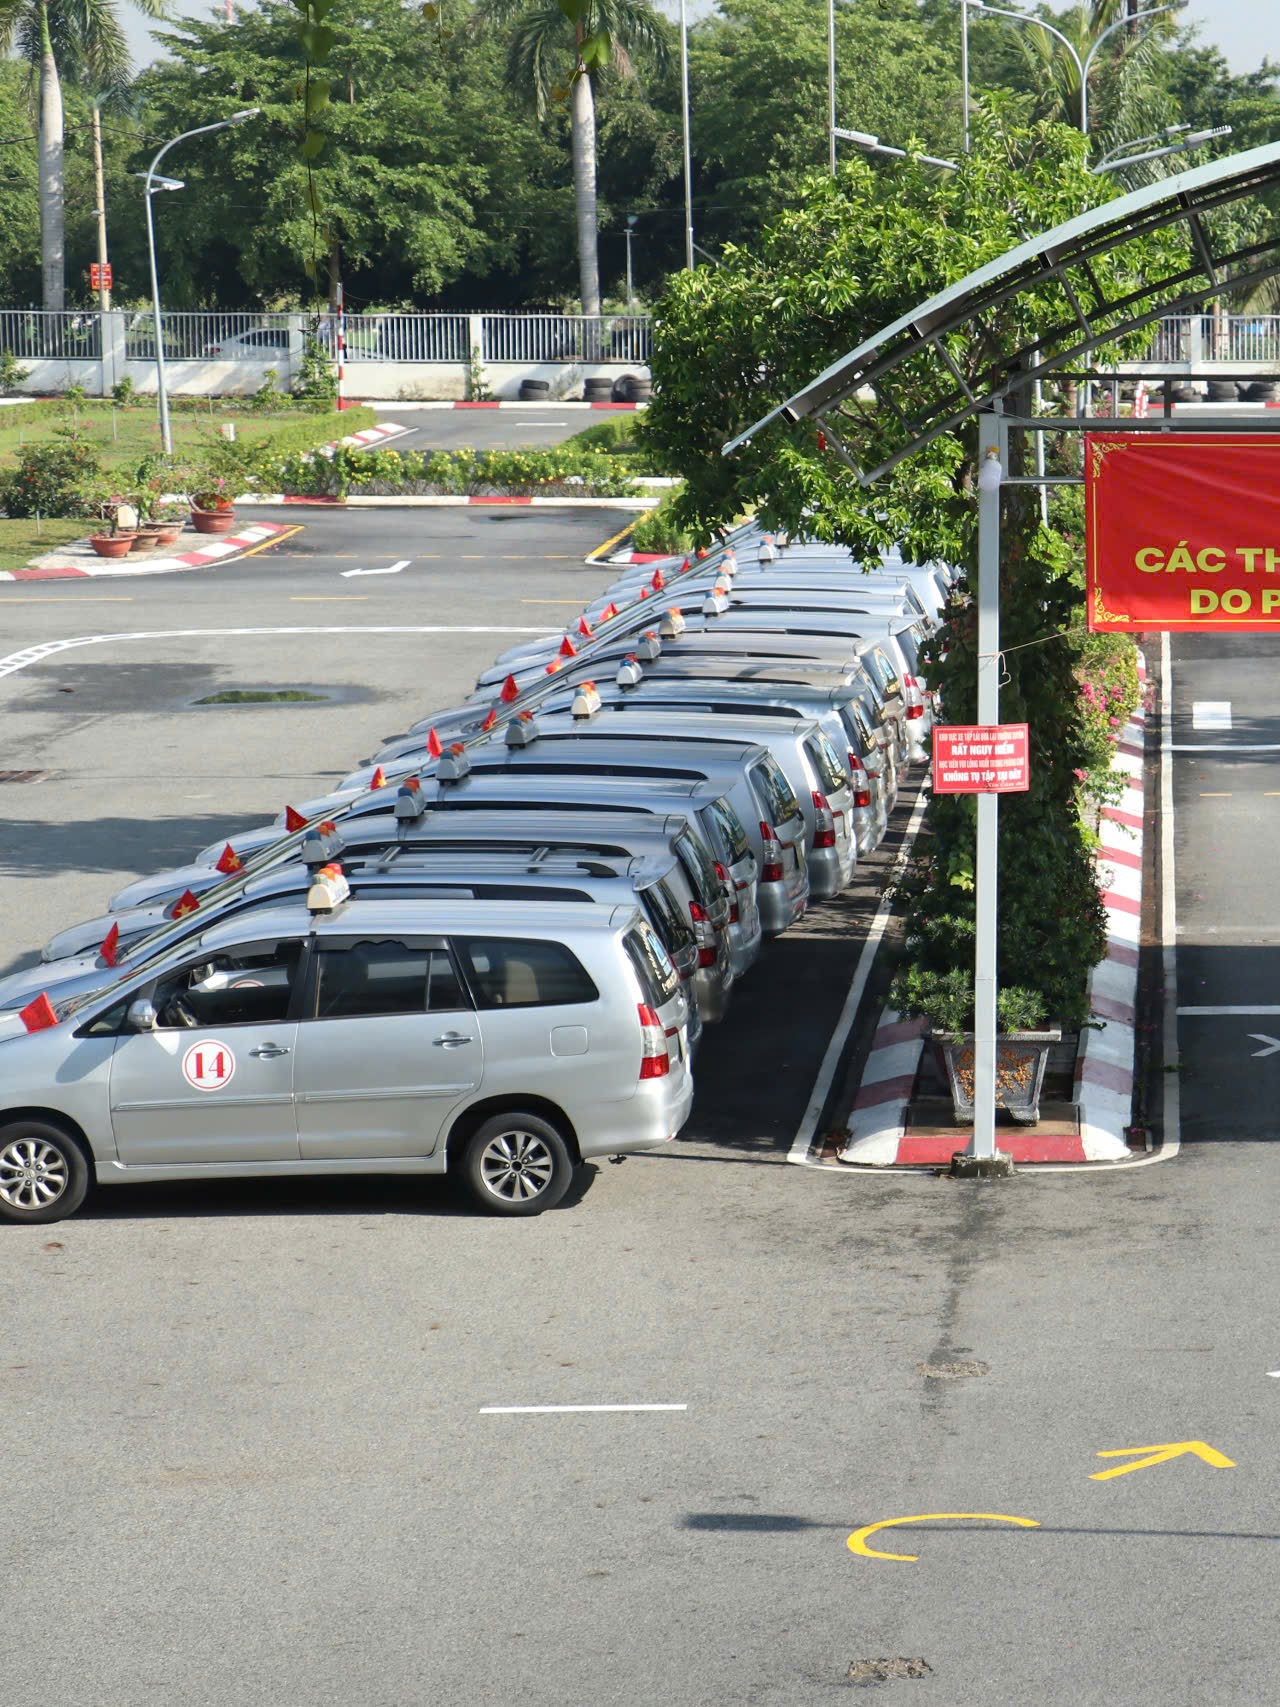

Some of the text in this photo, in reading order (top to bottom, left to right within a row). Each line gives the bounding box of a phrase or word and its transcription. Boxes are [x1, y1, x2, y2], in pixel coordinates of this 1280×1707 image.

[1135, 540, 1225, 573] CÁC
[1189, 588, 1252, 615] DO
[970, 745, 992, 755] NGUY
[944, 770, 968, 781] KHÔNG
[194, 1051, 226, 1079] 14
